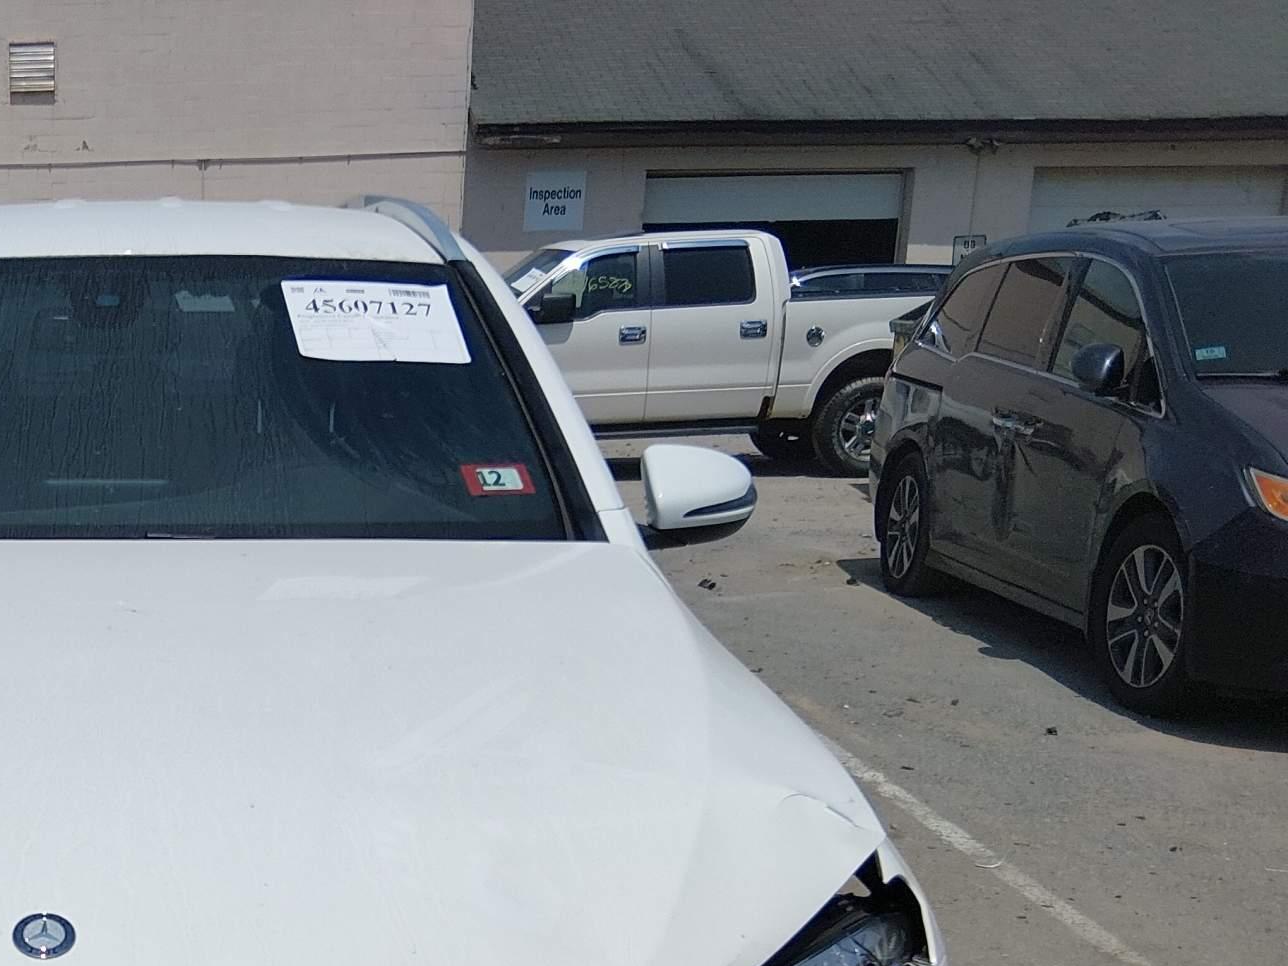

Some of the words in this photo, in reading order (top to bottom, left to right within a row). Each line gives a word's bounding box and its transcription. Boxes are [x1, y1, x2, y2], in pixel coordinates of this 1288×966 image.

[529, 187, 581, 202] Inspection
[542, 203, 566, 216] Area
[305, 298, 431, 317] 45607127
[476, 470, 507, 487] 12
